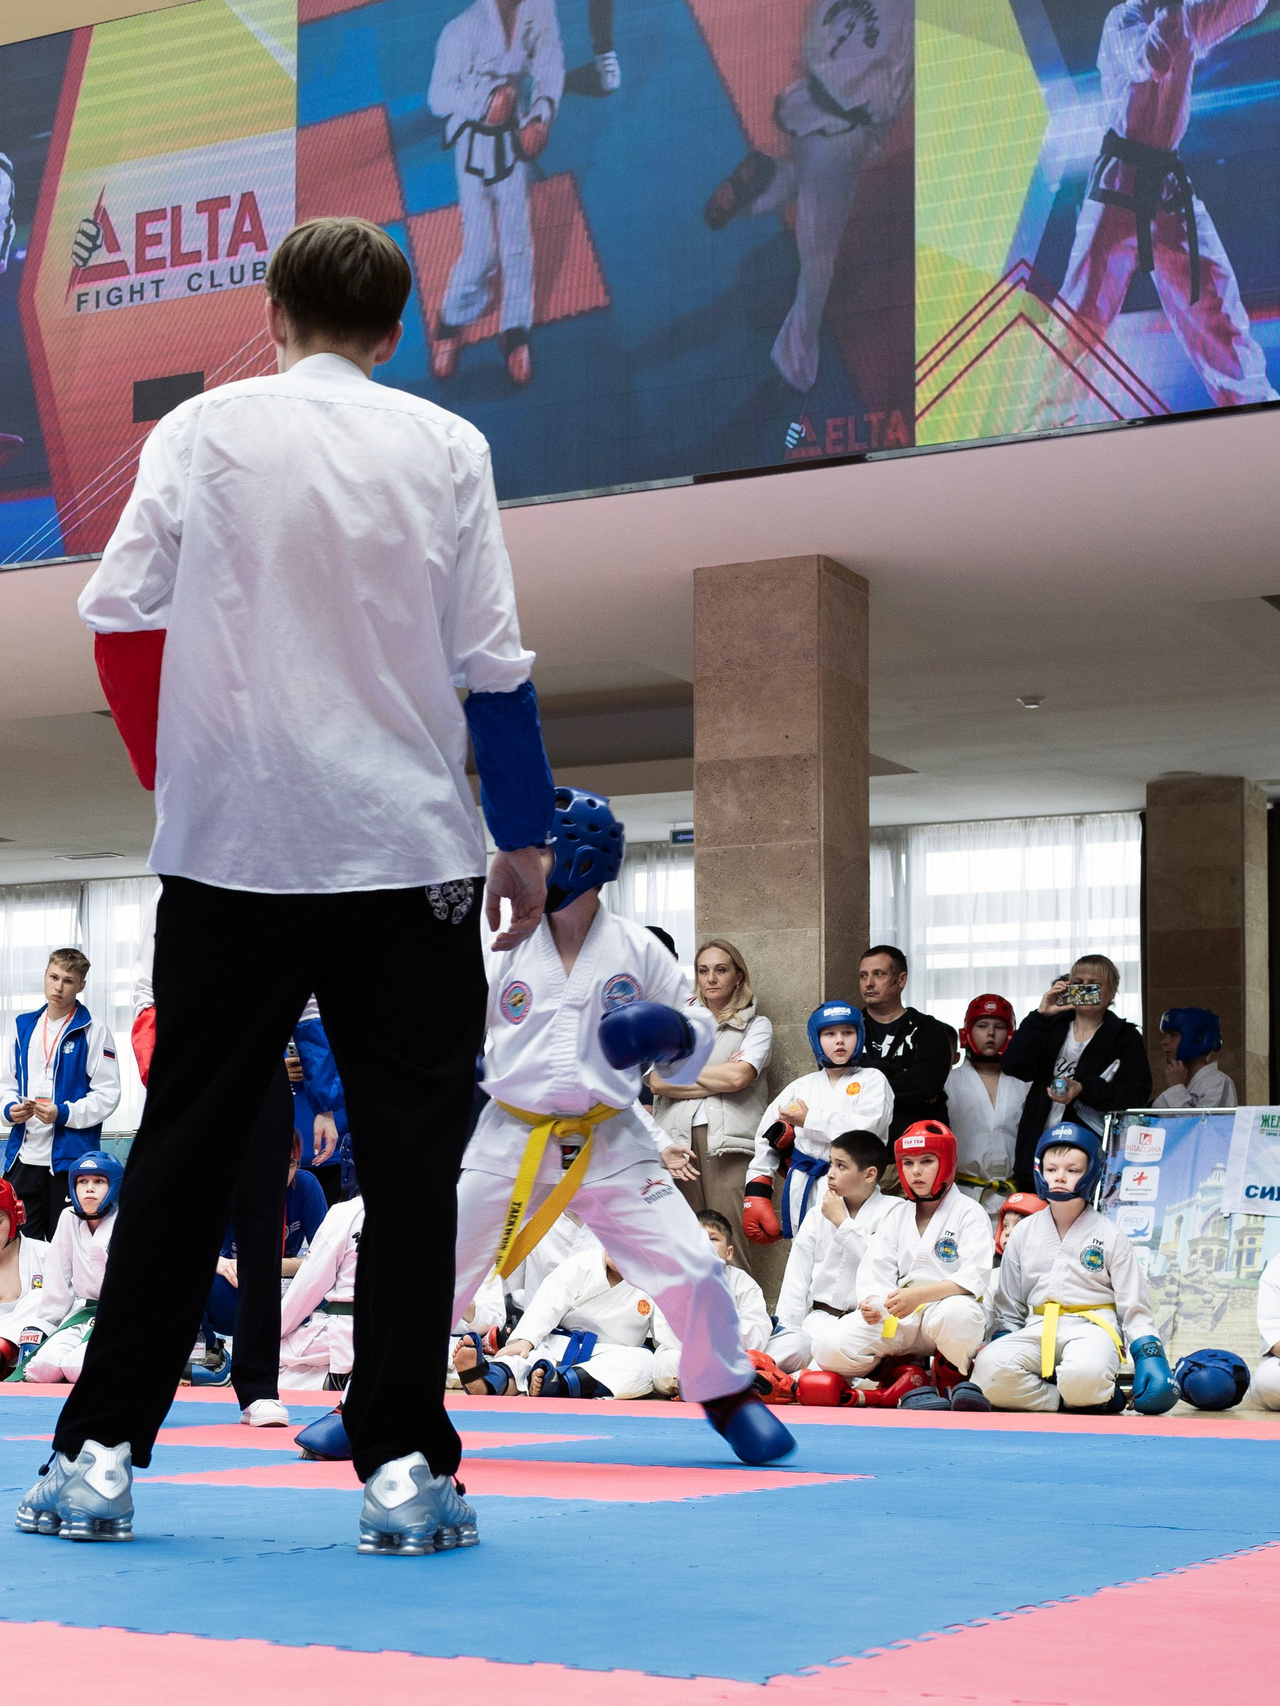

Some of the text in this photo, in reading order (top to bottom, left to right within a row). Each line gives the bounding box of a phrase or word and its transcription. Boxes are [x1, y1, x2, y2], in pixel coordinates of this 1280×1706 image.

[76, 260, 268, 313] FIGHT CLUB
[1127, 1145, 1162, 1153] КЛАССИКА
